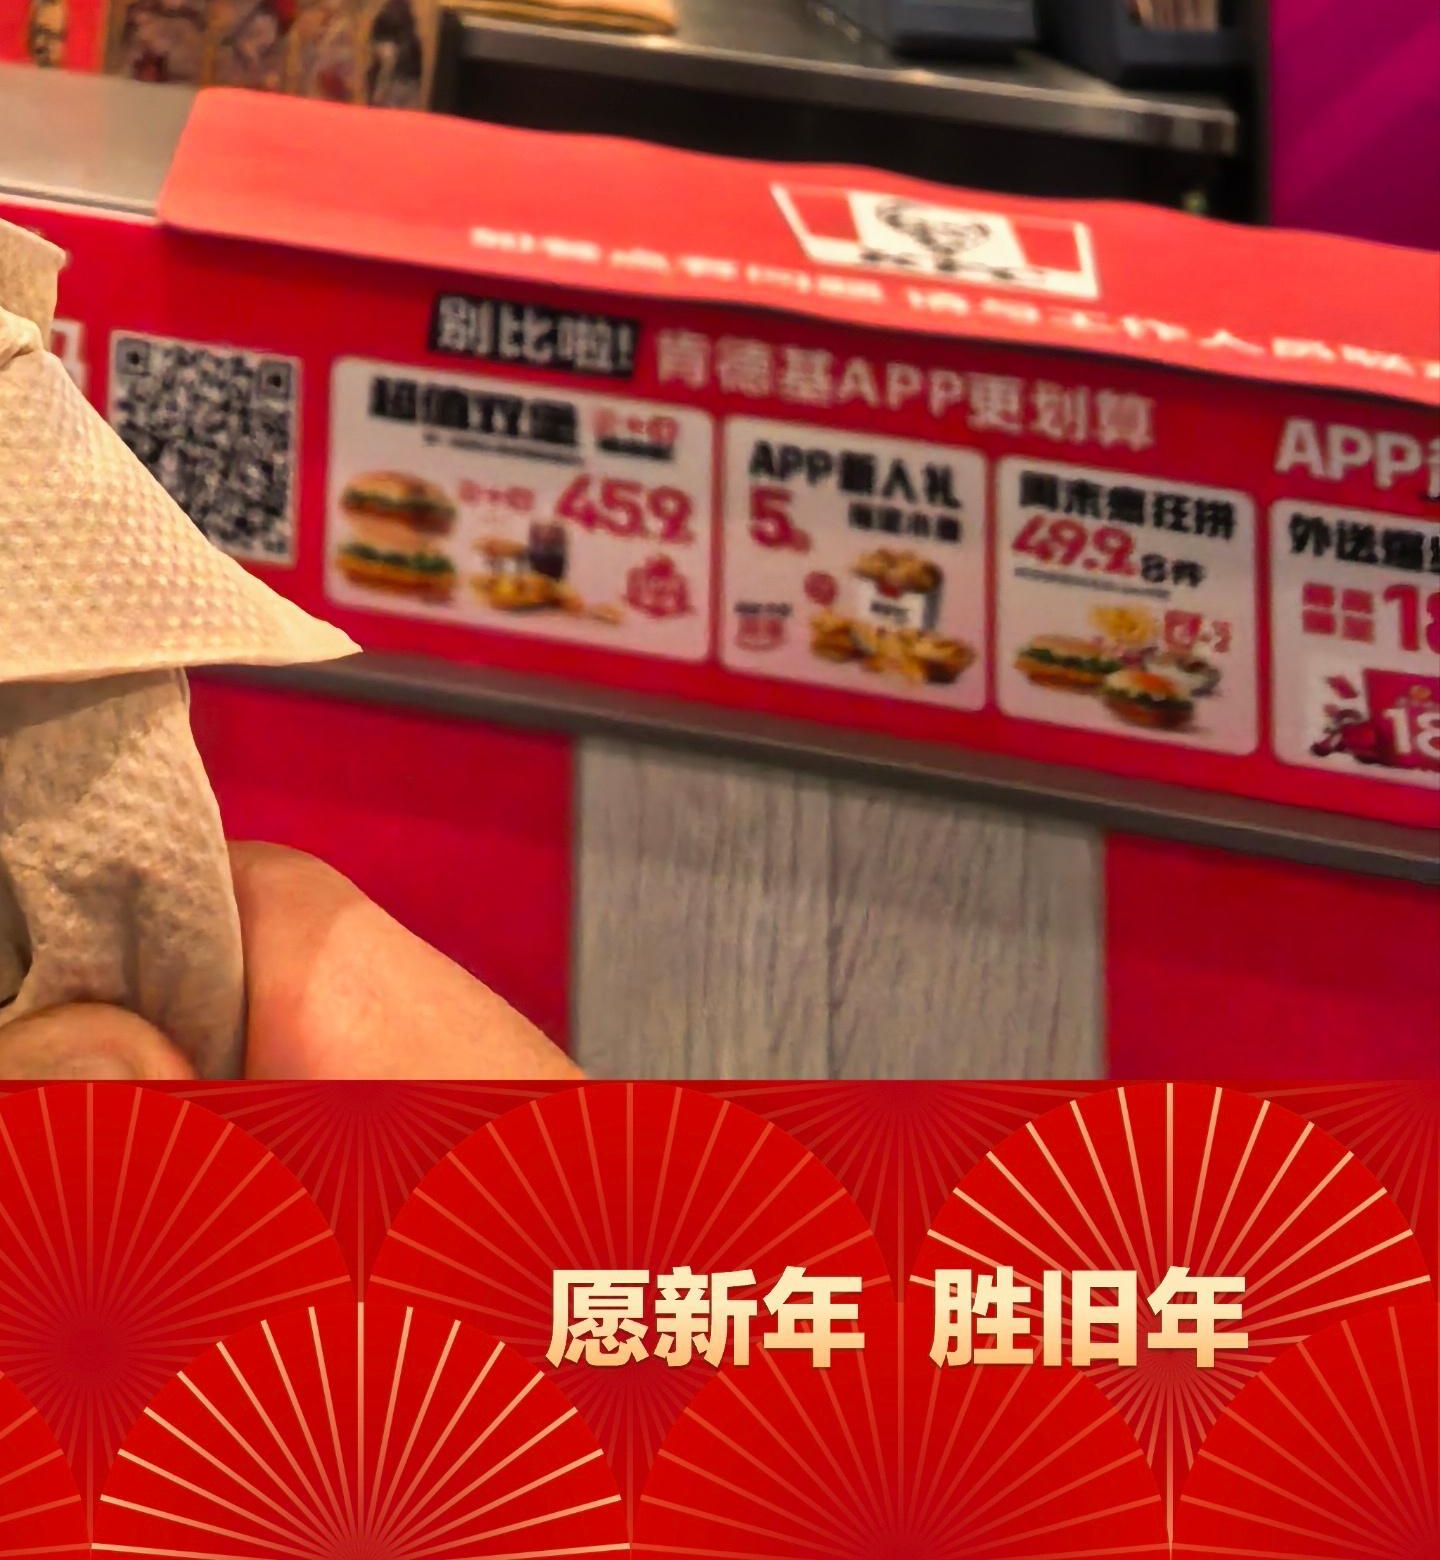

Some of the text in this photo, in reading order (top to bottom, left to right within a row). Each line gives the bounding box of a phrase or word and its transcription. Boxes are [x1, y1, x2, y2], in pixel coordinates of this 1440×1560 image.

[656, 328, 1157, 451] 肯德基APP更划算
